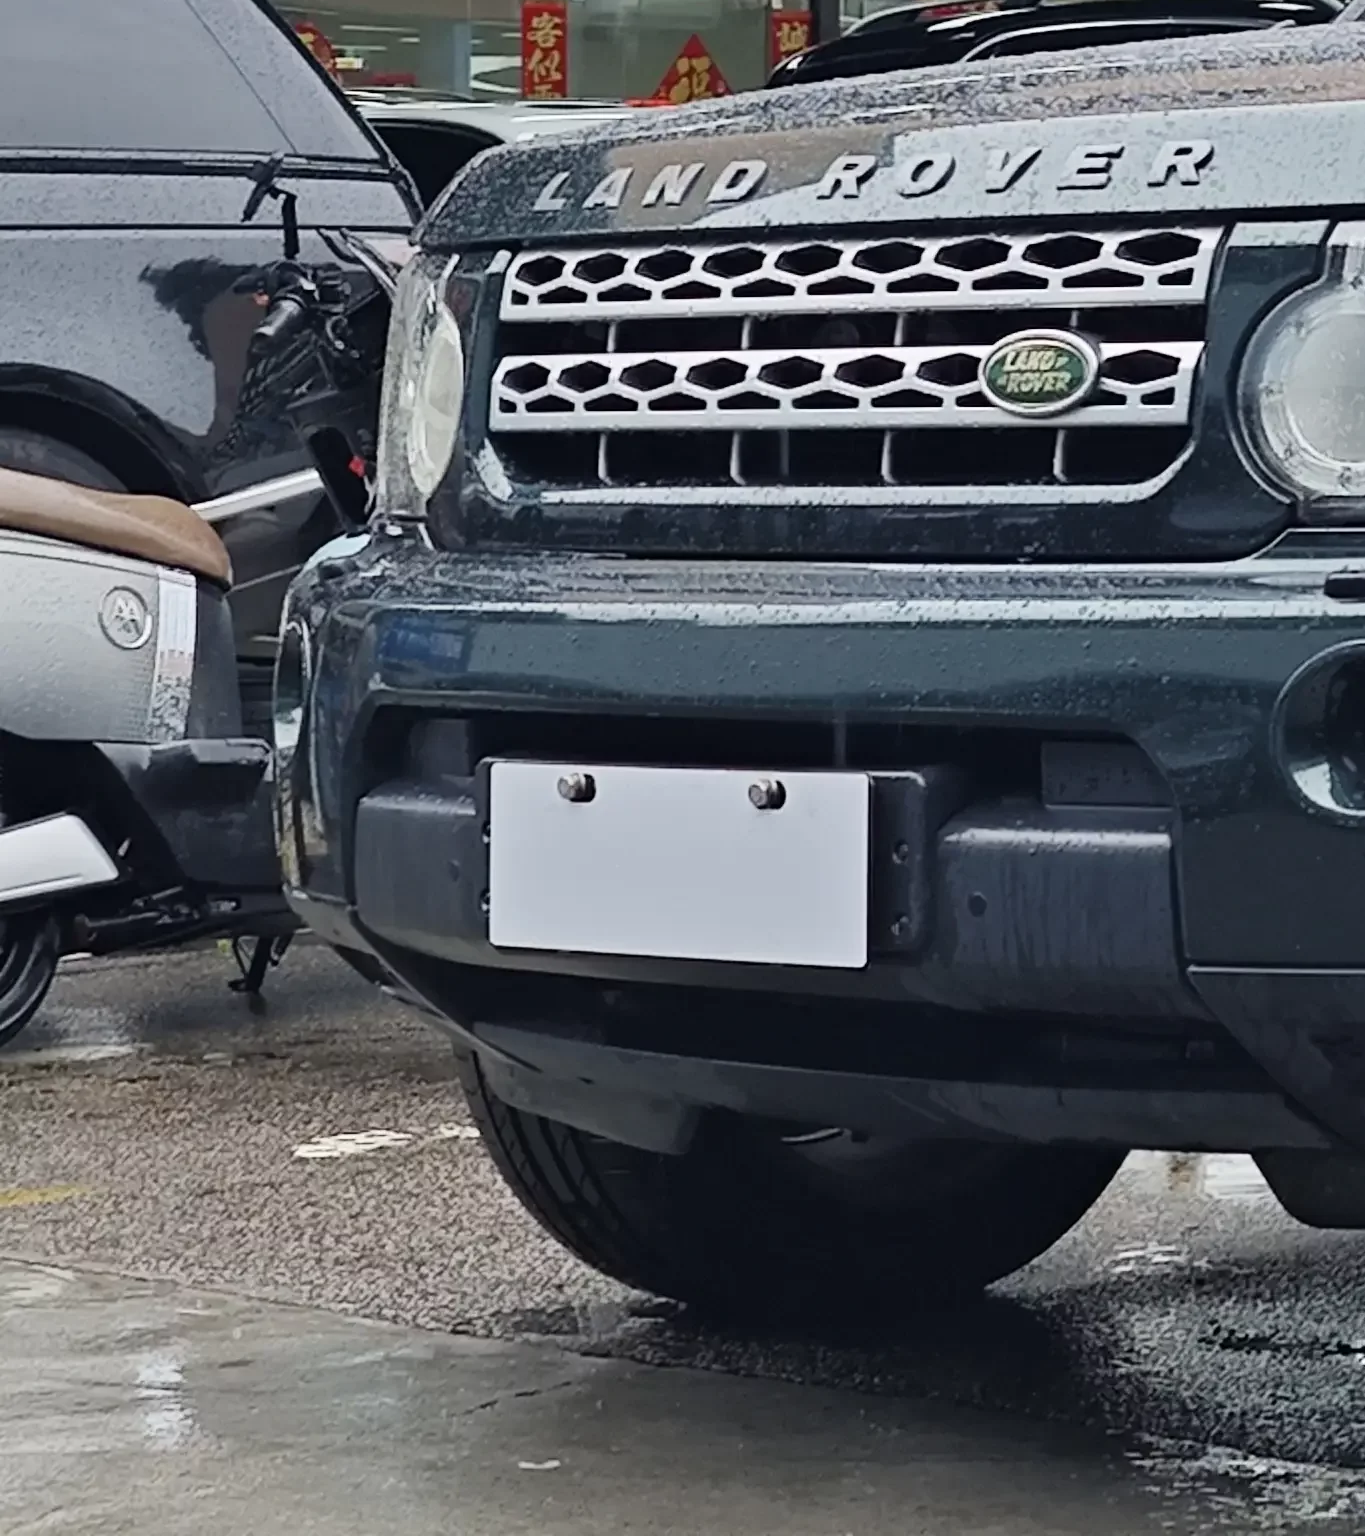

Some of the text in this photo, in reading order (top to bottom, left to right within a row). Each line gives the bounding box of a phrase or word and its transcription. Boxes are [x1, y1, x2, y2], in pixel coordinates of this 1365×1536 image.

[533, 139, 1215, 212] LAND ROVER
[1003, 350, 1057, 372] LAND
[1005, 371, 1072, 393] ROVER
